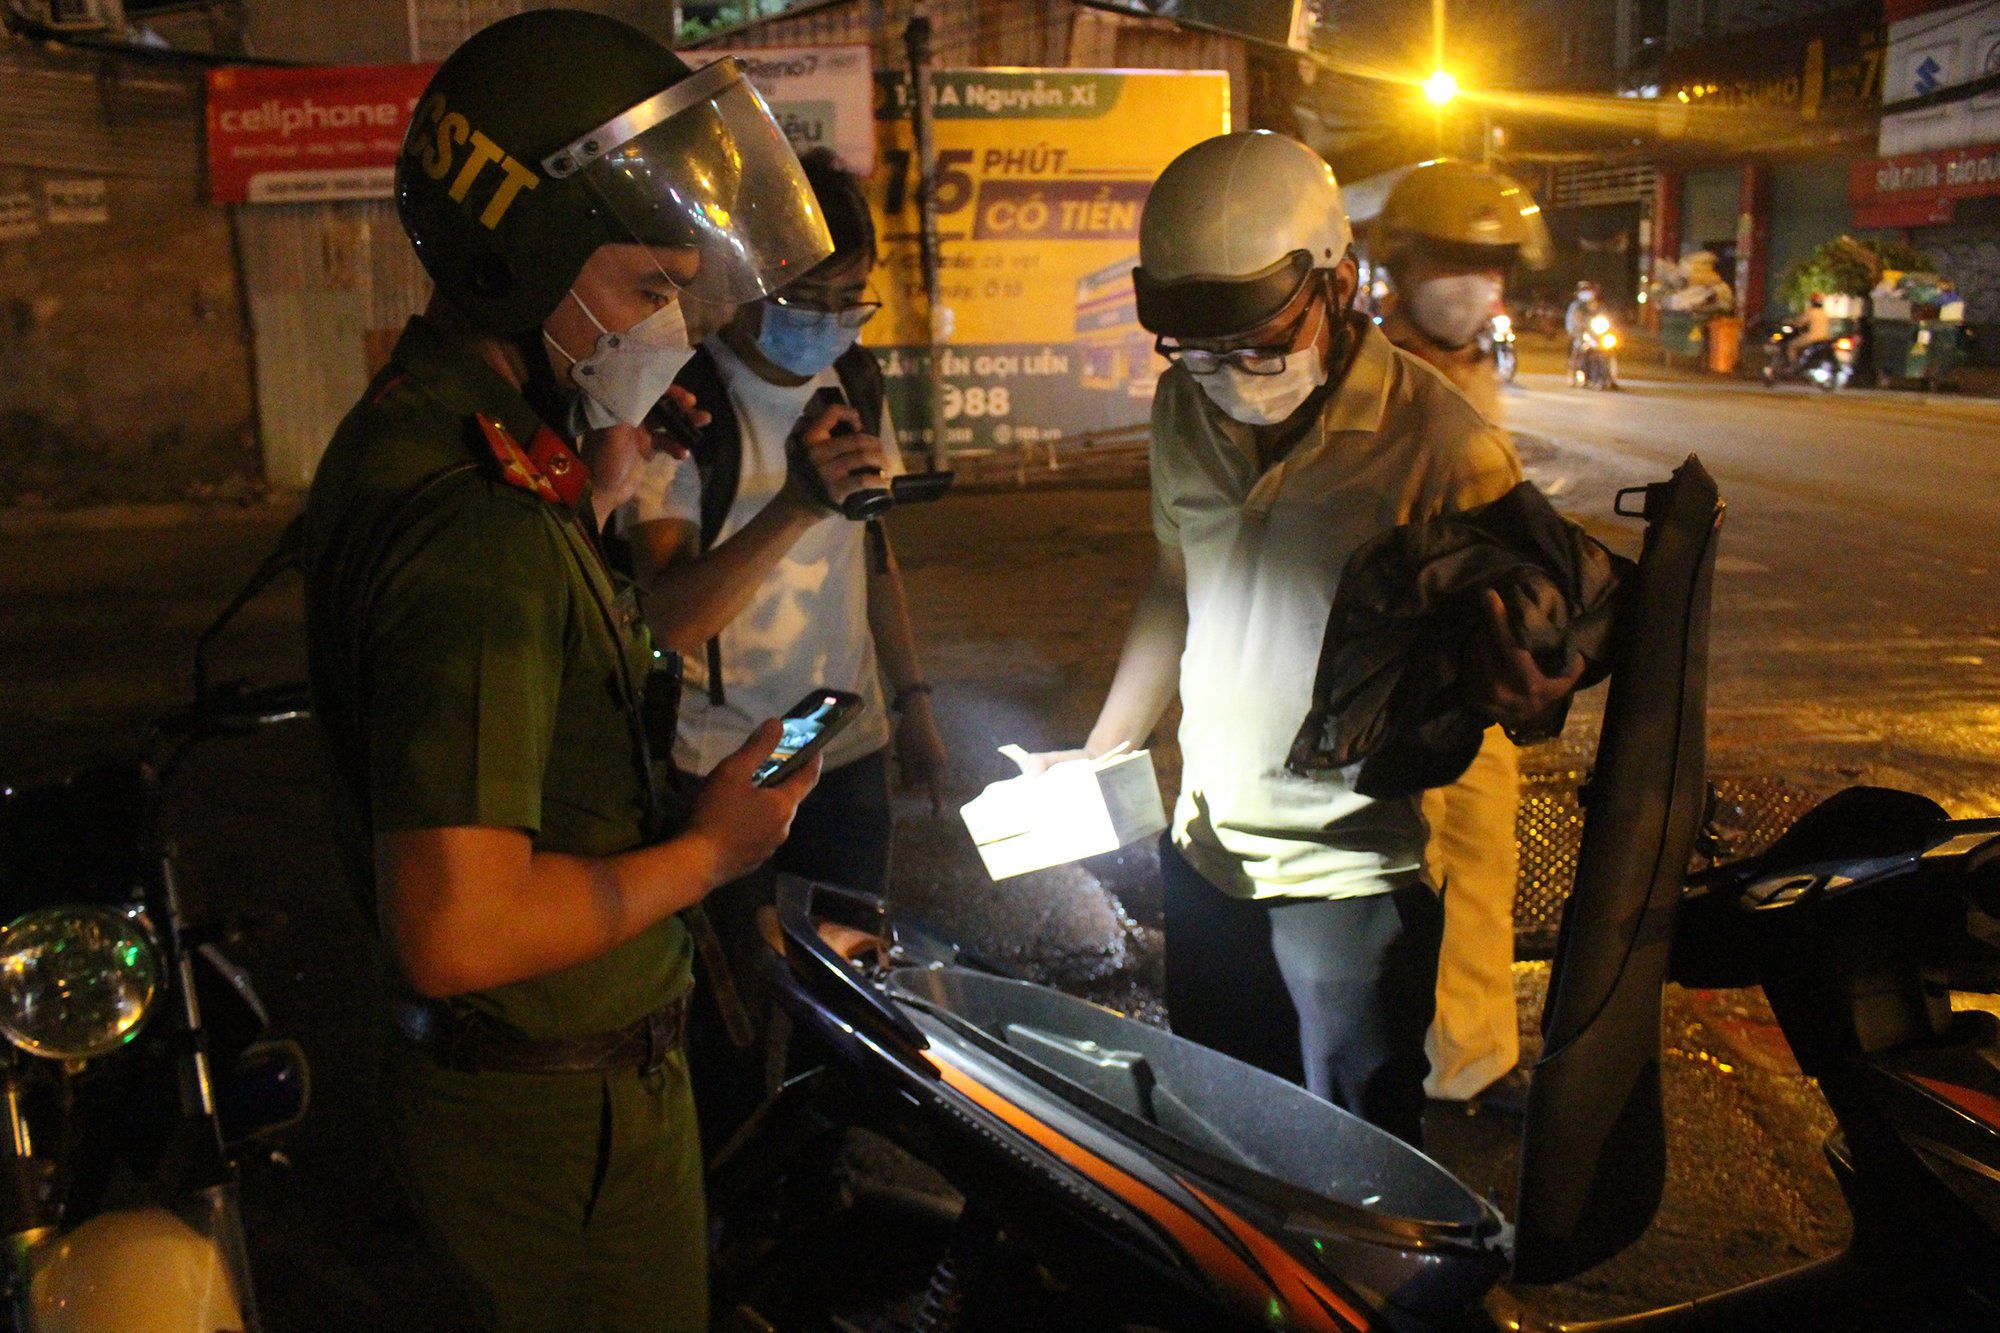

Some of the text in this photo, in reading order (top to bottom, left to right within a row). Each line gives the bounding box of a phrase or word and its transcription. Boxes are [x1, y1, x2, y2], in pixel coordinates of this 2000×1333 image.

[965, 79, 1063, 113] Nguyễn
[410, 91, 540, 230] CSTT
[981, 142, 1068, 184] PHÚT
[985, 185, 1136, 231] CÓ TIỀN
[974, 354, 1019, 379] GỌI
[1023, 346, 1069, 375] LIỀN
